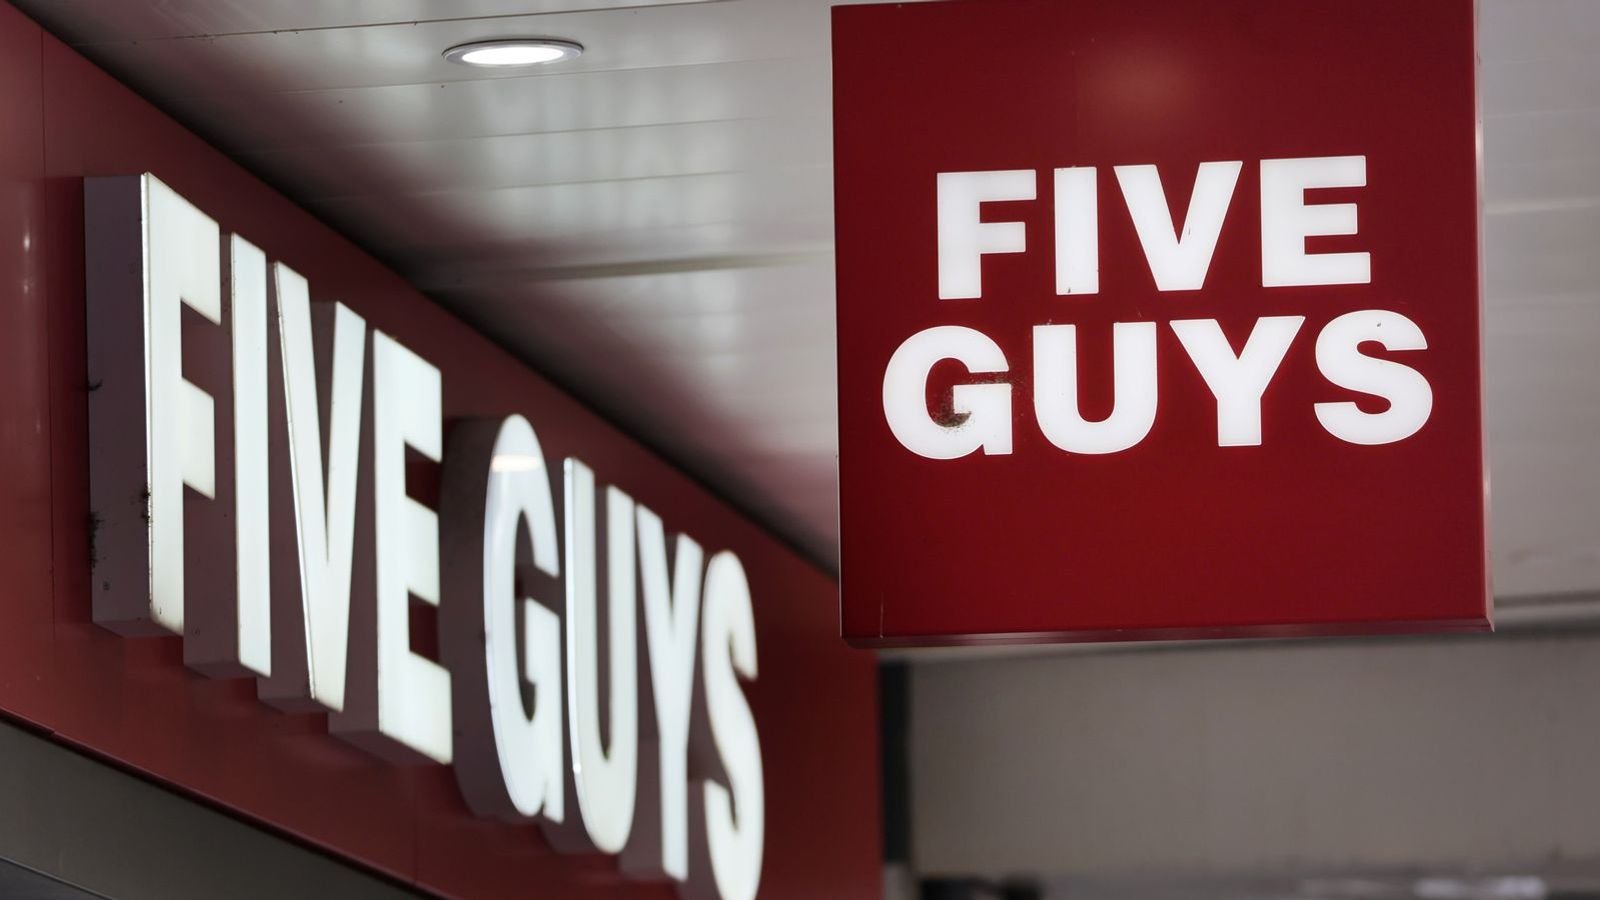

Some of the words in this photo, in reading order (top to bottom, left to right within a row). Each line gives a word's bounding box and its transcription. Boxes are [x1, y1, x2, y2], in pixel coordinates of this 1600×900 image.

[937, 155, 1371, 300] FIVE
[882, 310, 1433, 460] GUYS
[141, 172, 453, 764] FIVE
[483, 414, 765, 900] GUYS
